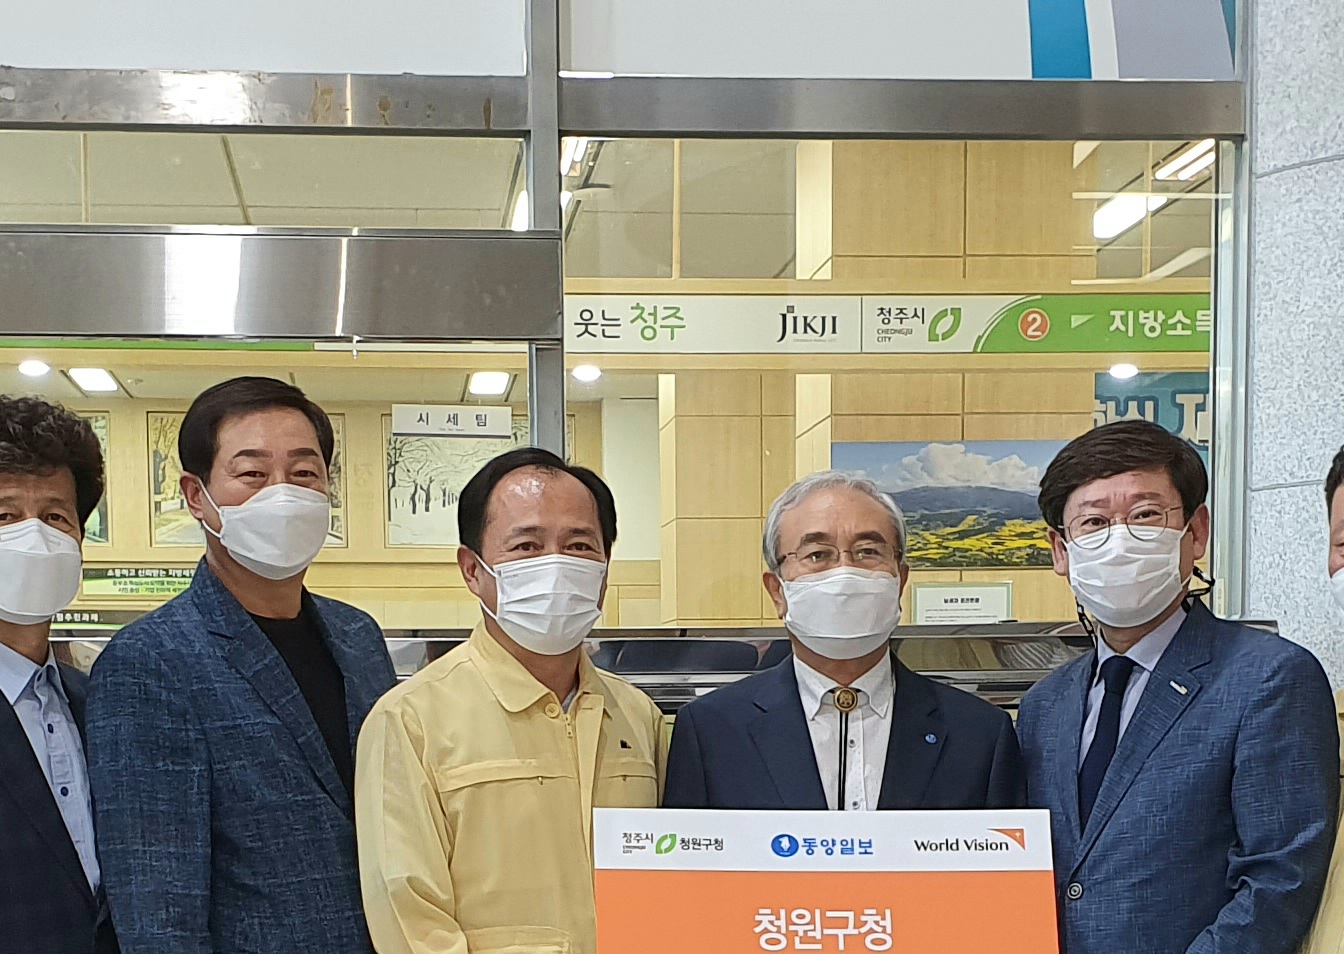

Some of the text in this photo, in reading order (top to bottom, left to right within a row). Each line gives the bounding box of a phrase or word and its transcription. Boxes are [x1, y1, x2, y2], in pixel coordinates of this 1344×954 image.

[573, 302, 687, 341] 웃는 청주
[776, 305, 838, 344] JIKJI
[876, 306, 925, 326] 청주시
[1026, 313, 1044, 337] 2
[416, 412, 488, 427] 시세팀
[679, 838, 724, 851] 청원구청
[801, 838, 874, 856] 동양일보
[914, 838, 1010, 852] World Vision
[752, 907, 894, 952] 청원구청
